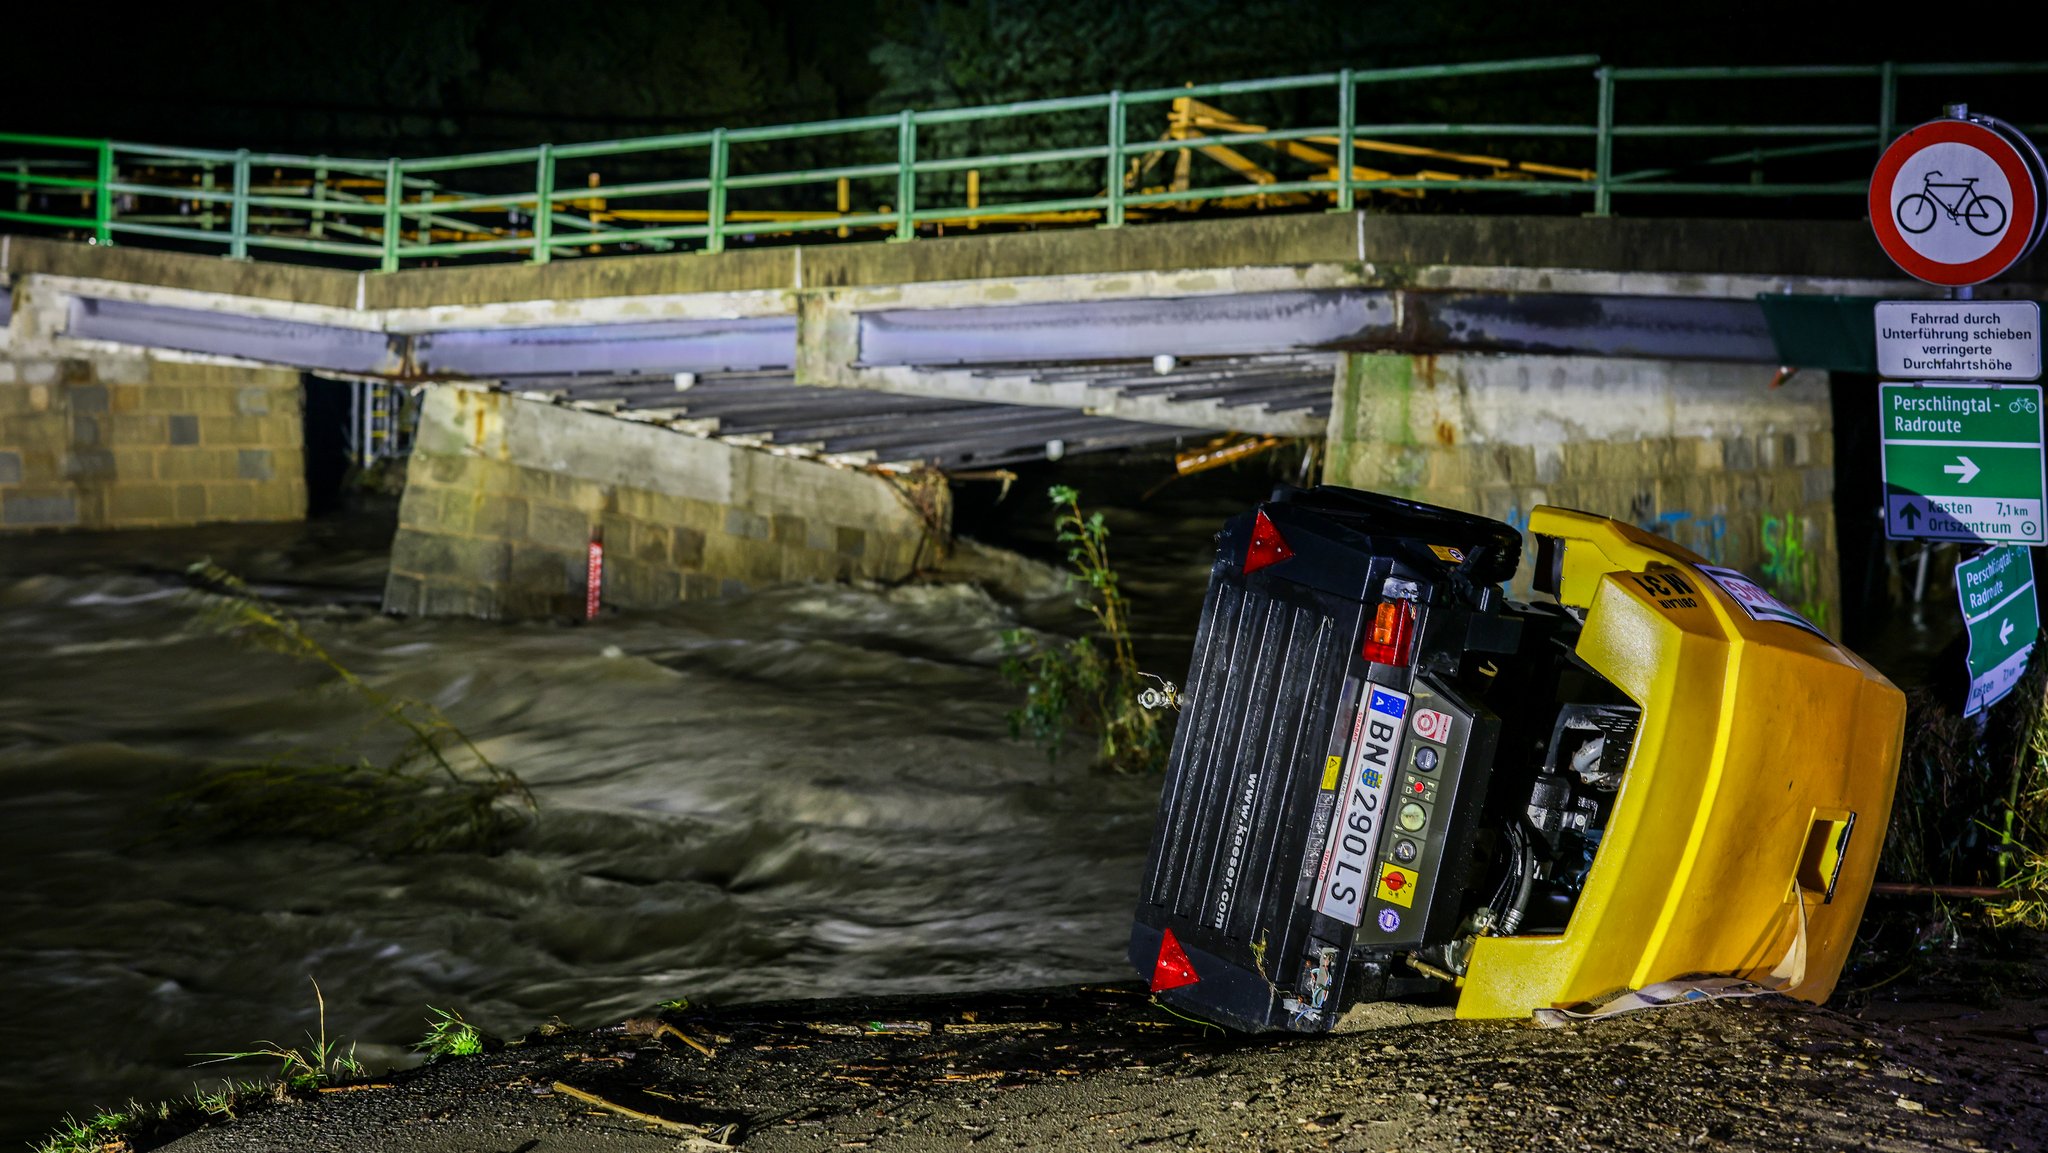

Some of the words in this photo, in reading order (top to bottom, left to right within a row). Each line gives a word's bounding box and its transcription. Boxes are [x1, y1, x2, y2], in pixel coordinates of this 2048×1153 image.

[1911, 312, 1959, 325] Fahrrad
[1964, 312, 2000, 325] durch
[1882, 327, 1969, 342] Unterführung
[1973, 328, 2032, 340] schieben
[1922, 344, 1993, 357] verringerte
[1903, 357, 2013, 371] Durchfahrtshöhe
[1895, 416, 1962, 433] Radroute
[1928, 500, 1973, 514] Kasten
[1996, 502, 2011, 517] 7,1
[2014, 506, 2029, 516] km
[1929, 518, 2012, 534] Ortszentrum
[1631, 574, 1672, 597] 31
[1969, 580, 2004, 609] Radroute
[1375, 695, 1386, 706] A
[1363, 720, 1394, 767] BN
[1215, 773, 1257, 929] www.kaeser.com
[1319, 847, 1331, 880] STRABAG
